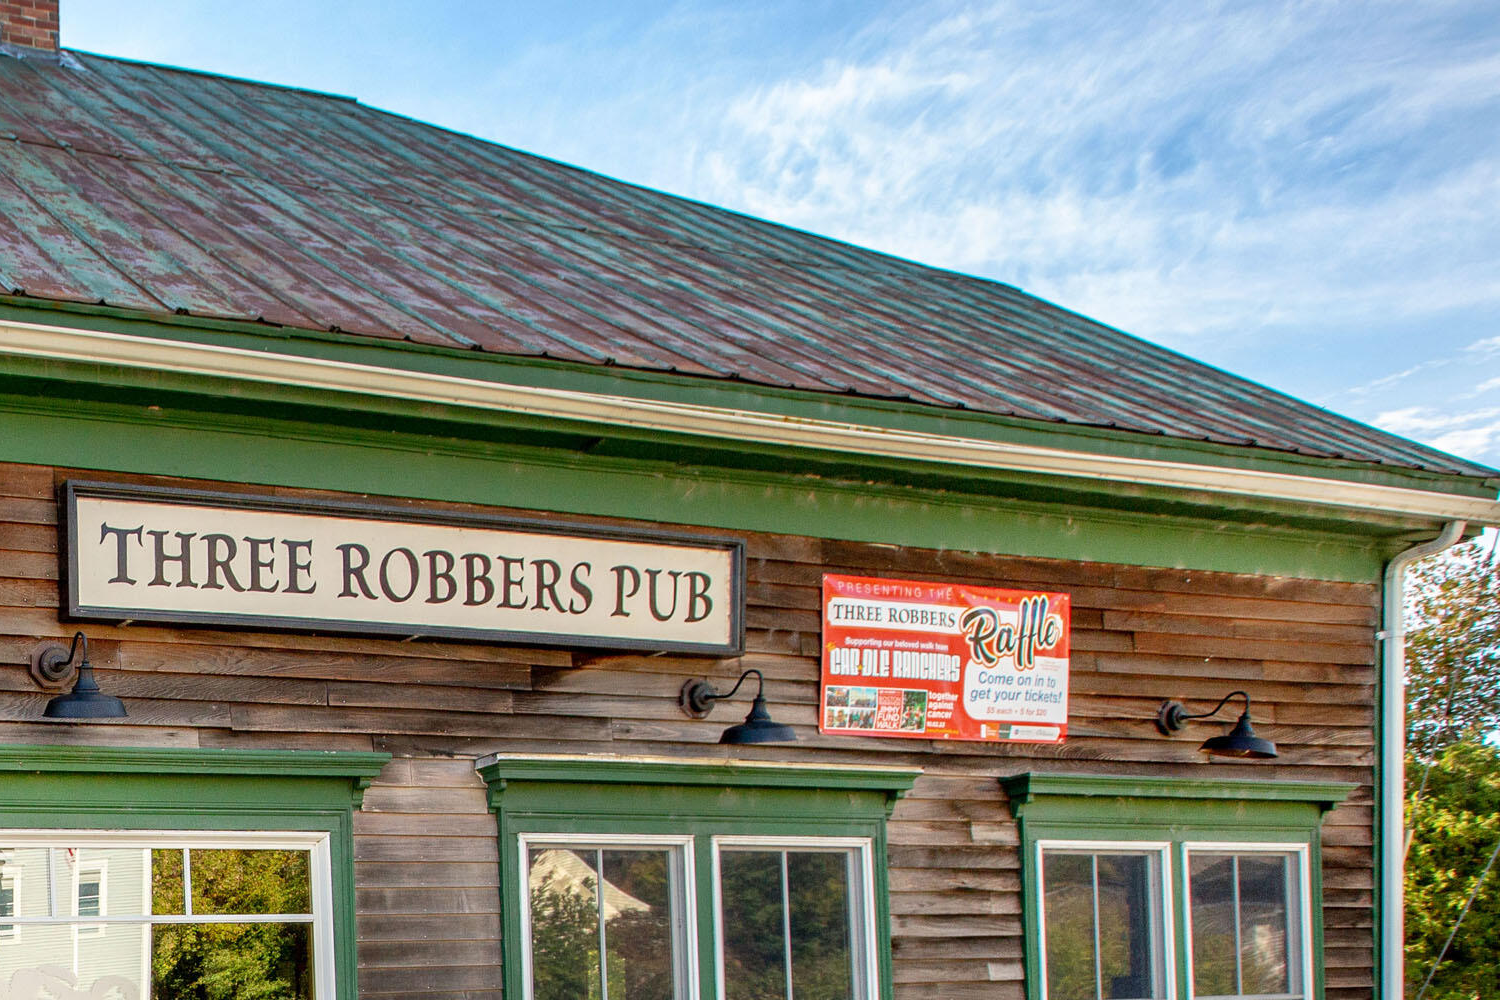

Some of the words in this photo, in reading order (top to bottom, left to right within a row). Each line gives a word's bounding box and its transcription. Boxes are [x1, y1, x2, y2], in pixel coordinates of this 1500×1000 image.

[100, 521, 318, 594] THREE
[336, 542, 594, 615] ROBBERS
[610, 564, 714, 623] PUB
[837, 581, 922, 598] PRESENTING
[929, 587, 953, 600] THE
[833, 604, 882, 622] THREE
[888, 607, 956, 628] ROBBERS
[961, 594, 1060, 669] Raffle
[844, 636, 882, 648] Supporting
[978, 671, 1014, 686] Come
[1017, 675, 1031, 686] on
[1034, 673, 1044, 687] in
[1047, 675, 1056, 688] to
[928, 691, 959, 702] together
[970, 687, 991, 702] get
[994, 689, 1021, 702] your
[1024, 689, 1062, 704] tickets!
[877, 712, 900, 721] FUND
[927, 711, 952, 719] cancer
[876, 720, 899, 729] WALK
